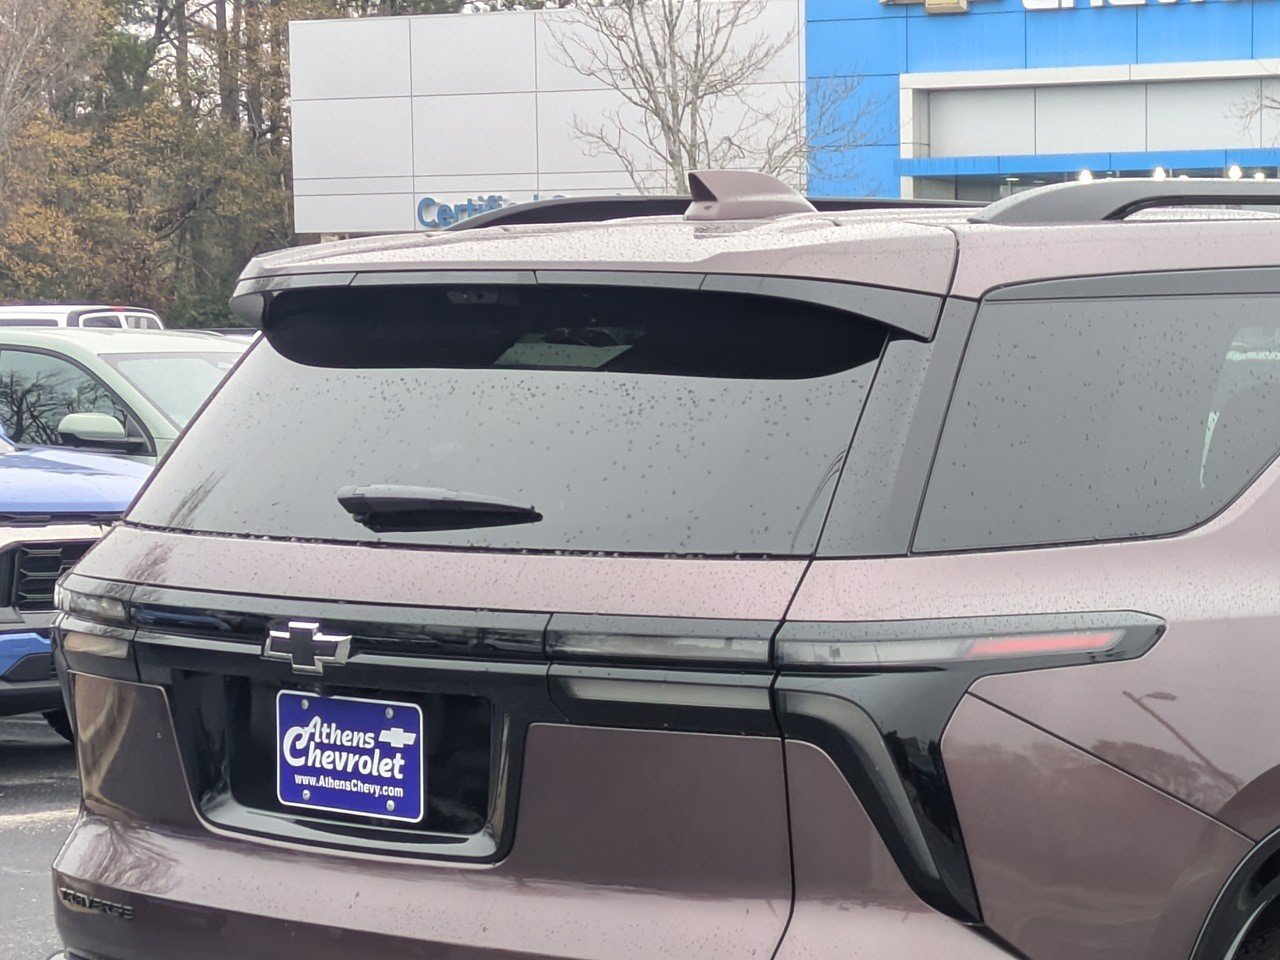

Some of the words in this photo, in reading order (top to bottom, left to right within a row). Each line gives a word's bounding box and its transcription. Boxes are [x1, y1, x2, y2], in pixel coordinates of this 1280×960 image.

[417, 194, 540, 229] Certif
[297, 716, 375, 749] Athens
[283, 726, 405, 779] Chevrolet
[294, 774, 403, 797] www.AthensChevy.com
